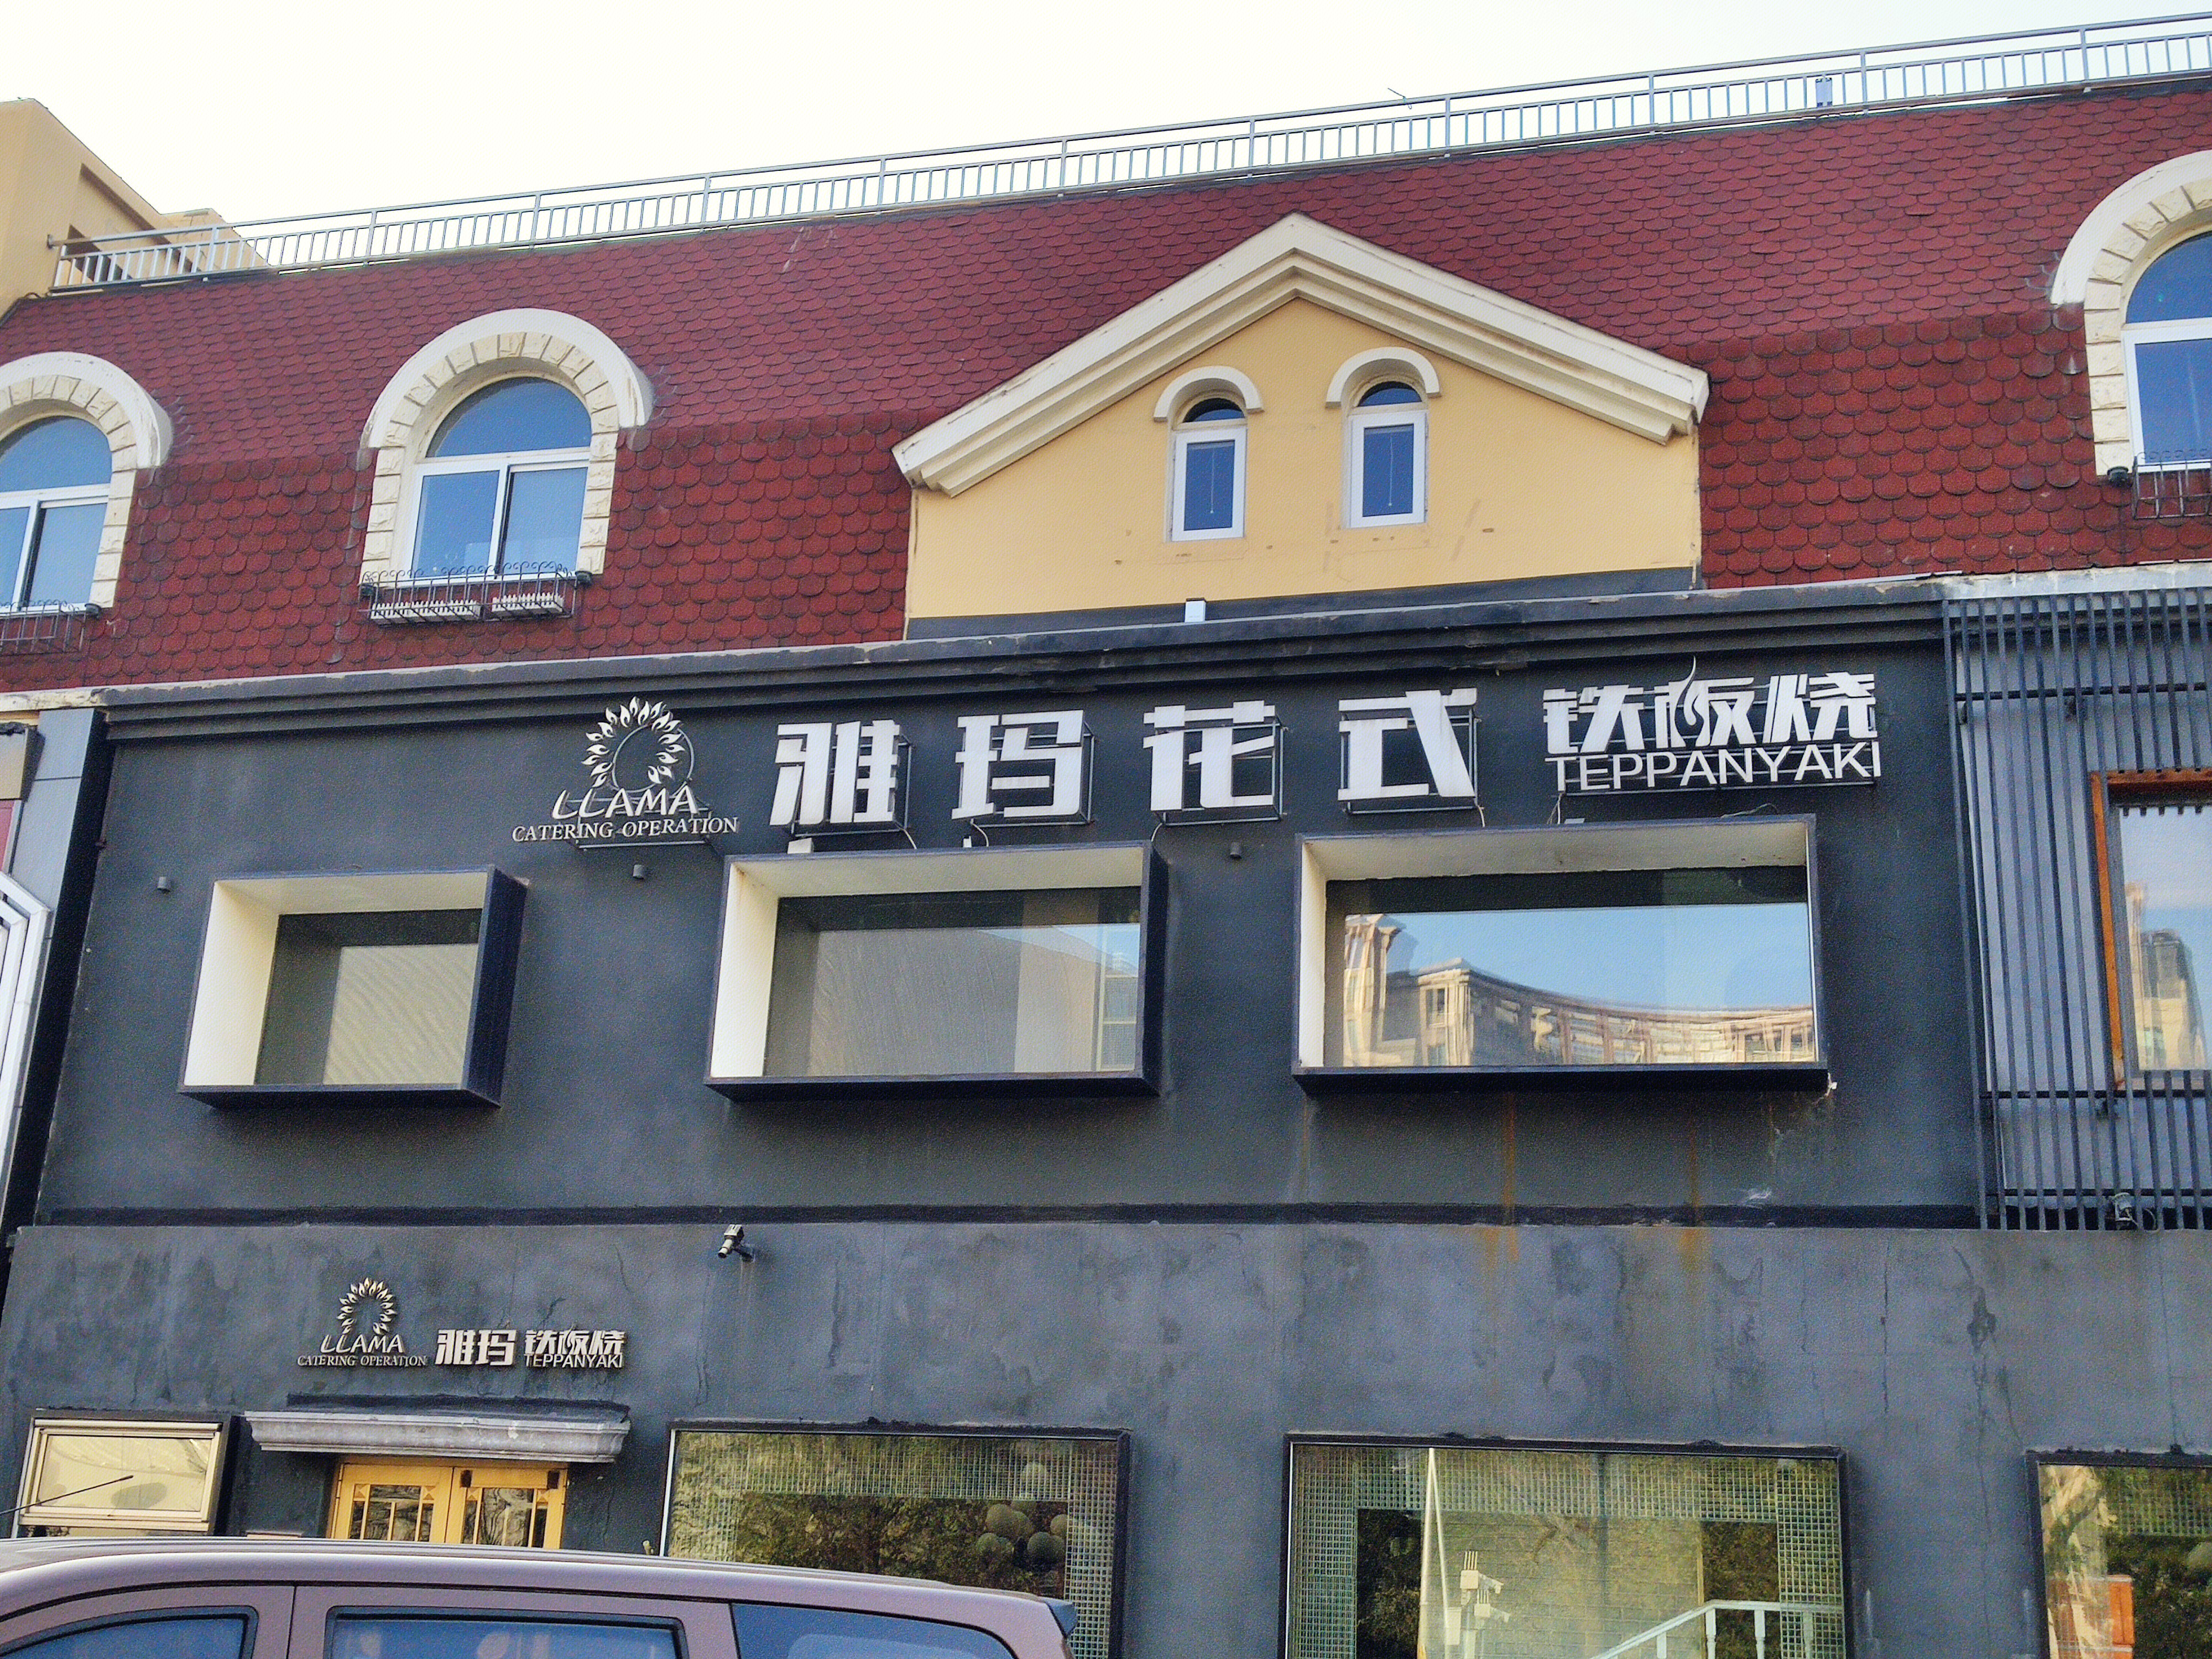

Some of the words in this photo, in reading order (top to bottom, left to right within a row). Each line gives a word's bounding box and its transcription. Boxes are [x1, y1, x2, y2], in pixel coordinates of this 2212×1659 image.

[1543, 658, 1878, 754] 铁板烧
[1545, 741, 1881, 791] TEPPANYAKI
[552, 785, 699, 820] LLAMA
[512, 822, 614, 842] CATERING
[623, 817, 739, 837] OPERATION
[320, 1334, 403, 1353] LLAMA
[435, 1329, 518, 1365] 雅玛
[525, 1328, 625, 1355] 铁板烧
[297, 1354, 356, 1366] CATERING
[361, 1355, 426, 1367] OPERATION
[525, 1355, 623, 1368] TEPPANYAKI
